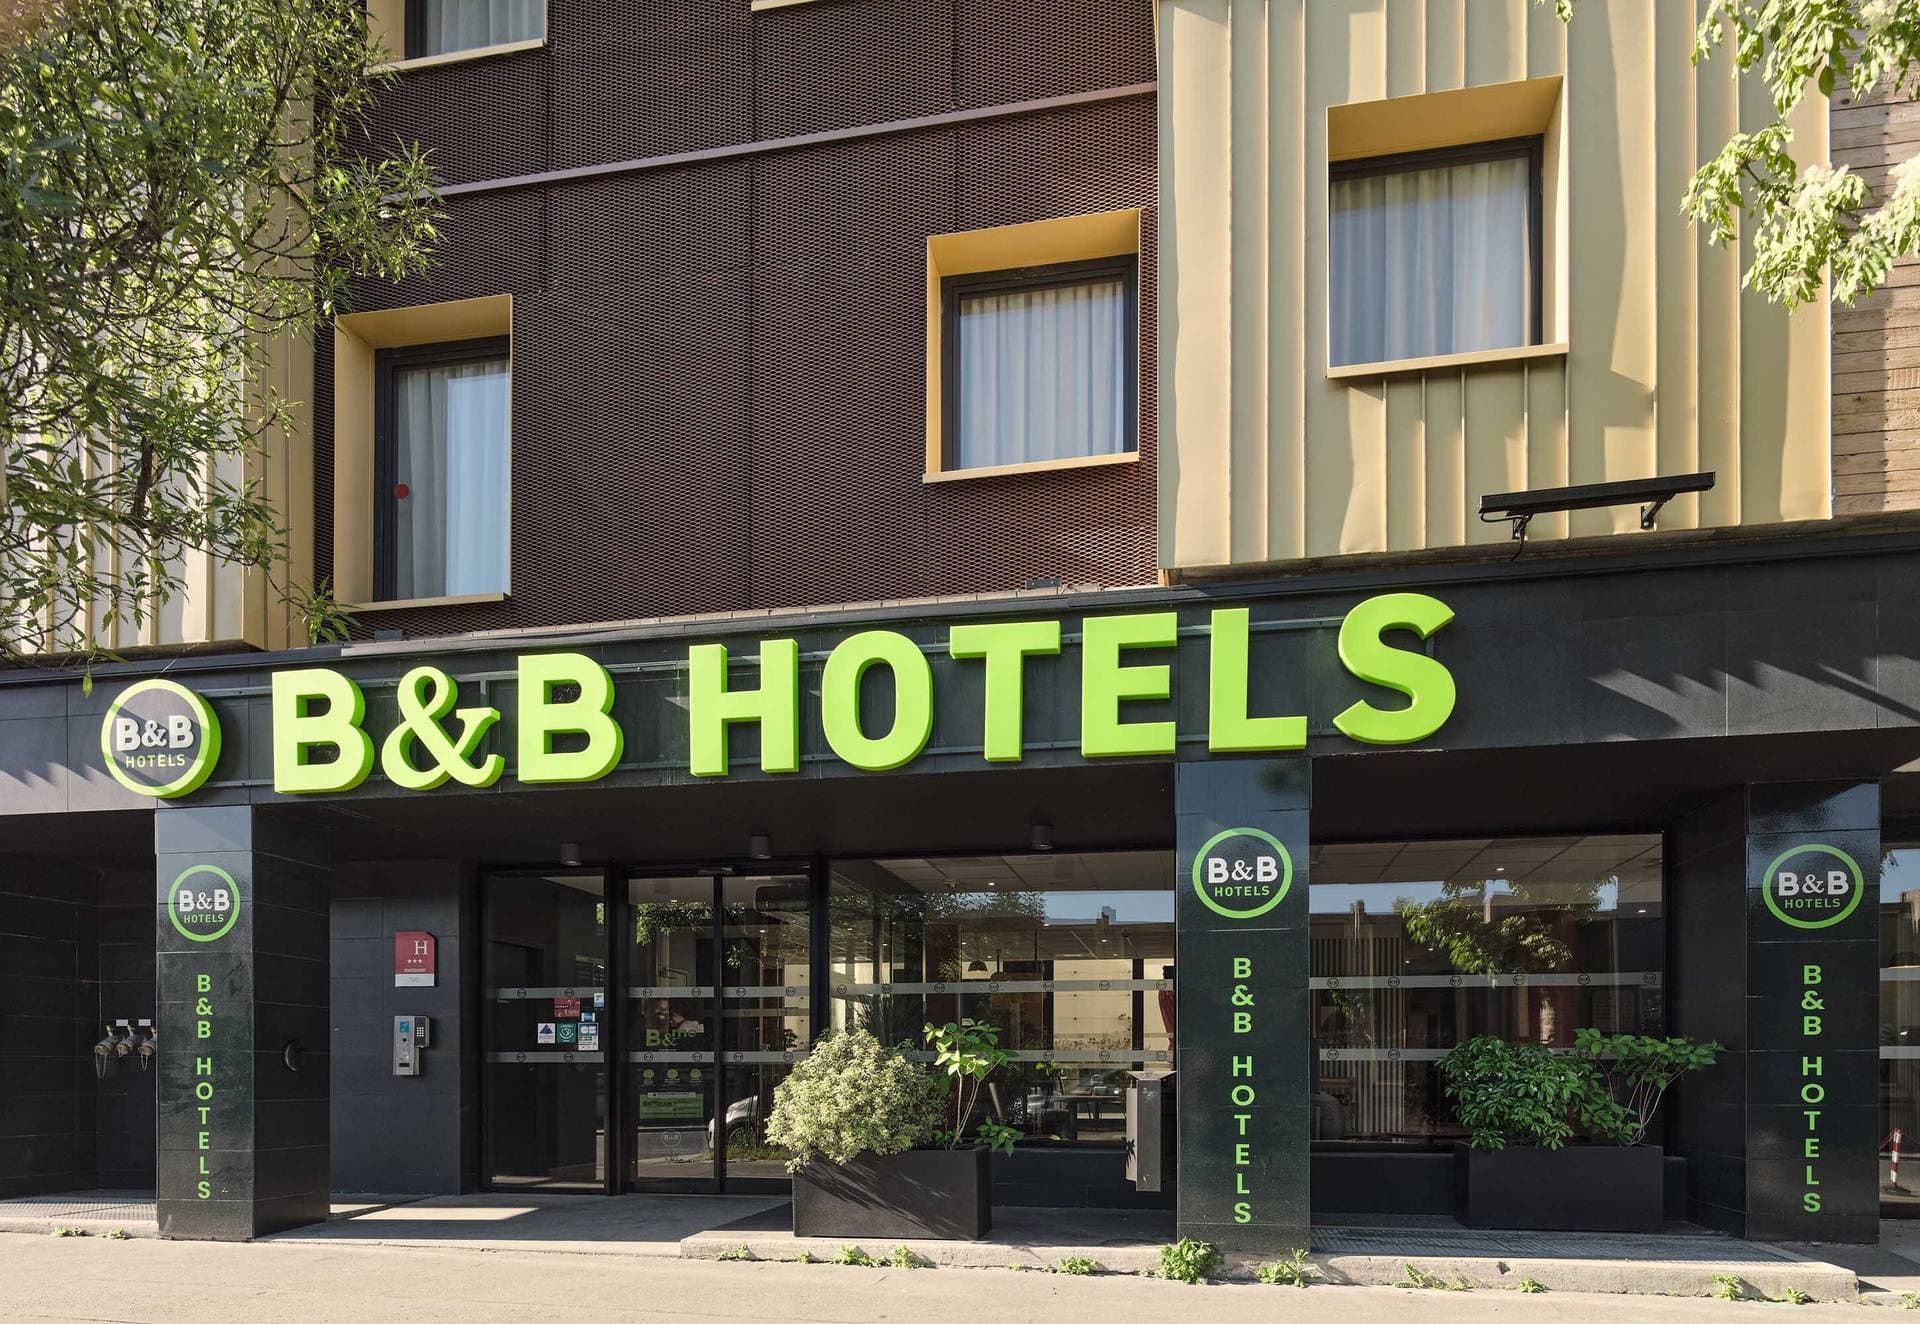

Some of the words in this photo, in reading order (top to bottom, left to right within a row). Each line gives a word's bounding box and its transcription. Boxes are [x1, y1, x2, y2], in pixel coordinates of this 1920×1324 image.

[272, 653, 624, 795] B&B
[688, 593, 1456, 778] HOTELS
[116, 715, 194, 751] B&B
[126, 754, 186, 768] HOTELS
[1207, 856, 1278, 884] B&B
[1778, 870, 1849, 895] B&B
[179, 889, 230, 912] B&B
[1214, 886, 1270, 897] HOTELS
[1784, 898, 1841, 908] HOTELS
[183, 914, 224, 923] HOTELS
[413, 940, 428, 956] H
[195, 974, 214, 1039] B&B
[1231, 957, 1256, 1034] B&B
[1800, 965, 1825, 1036] B&B
[195, 1057, 213, 1200] HOTELS
[1230, 1055, 1255, 1224] HOTELS
[1800, 1056, 1825, 1213] HOTELS
